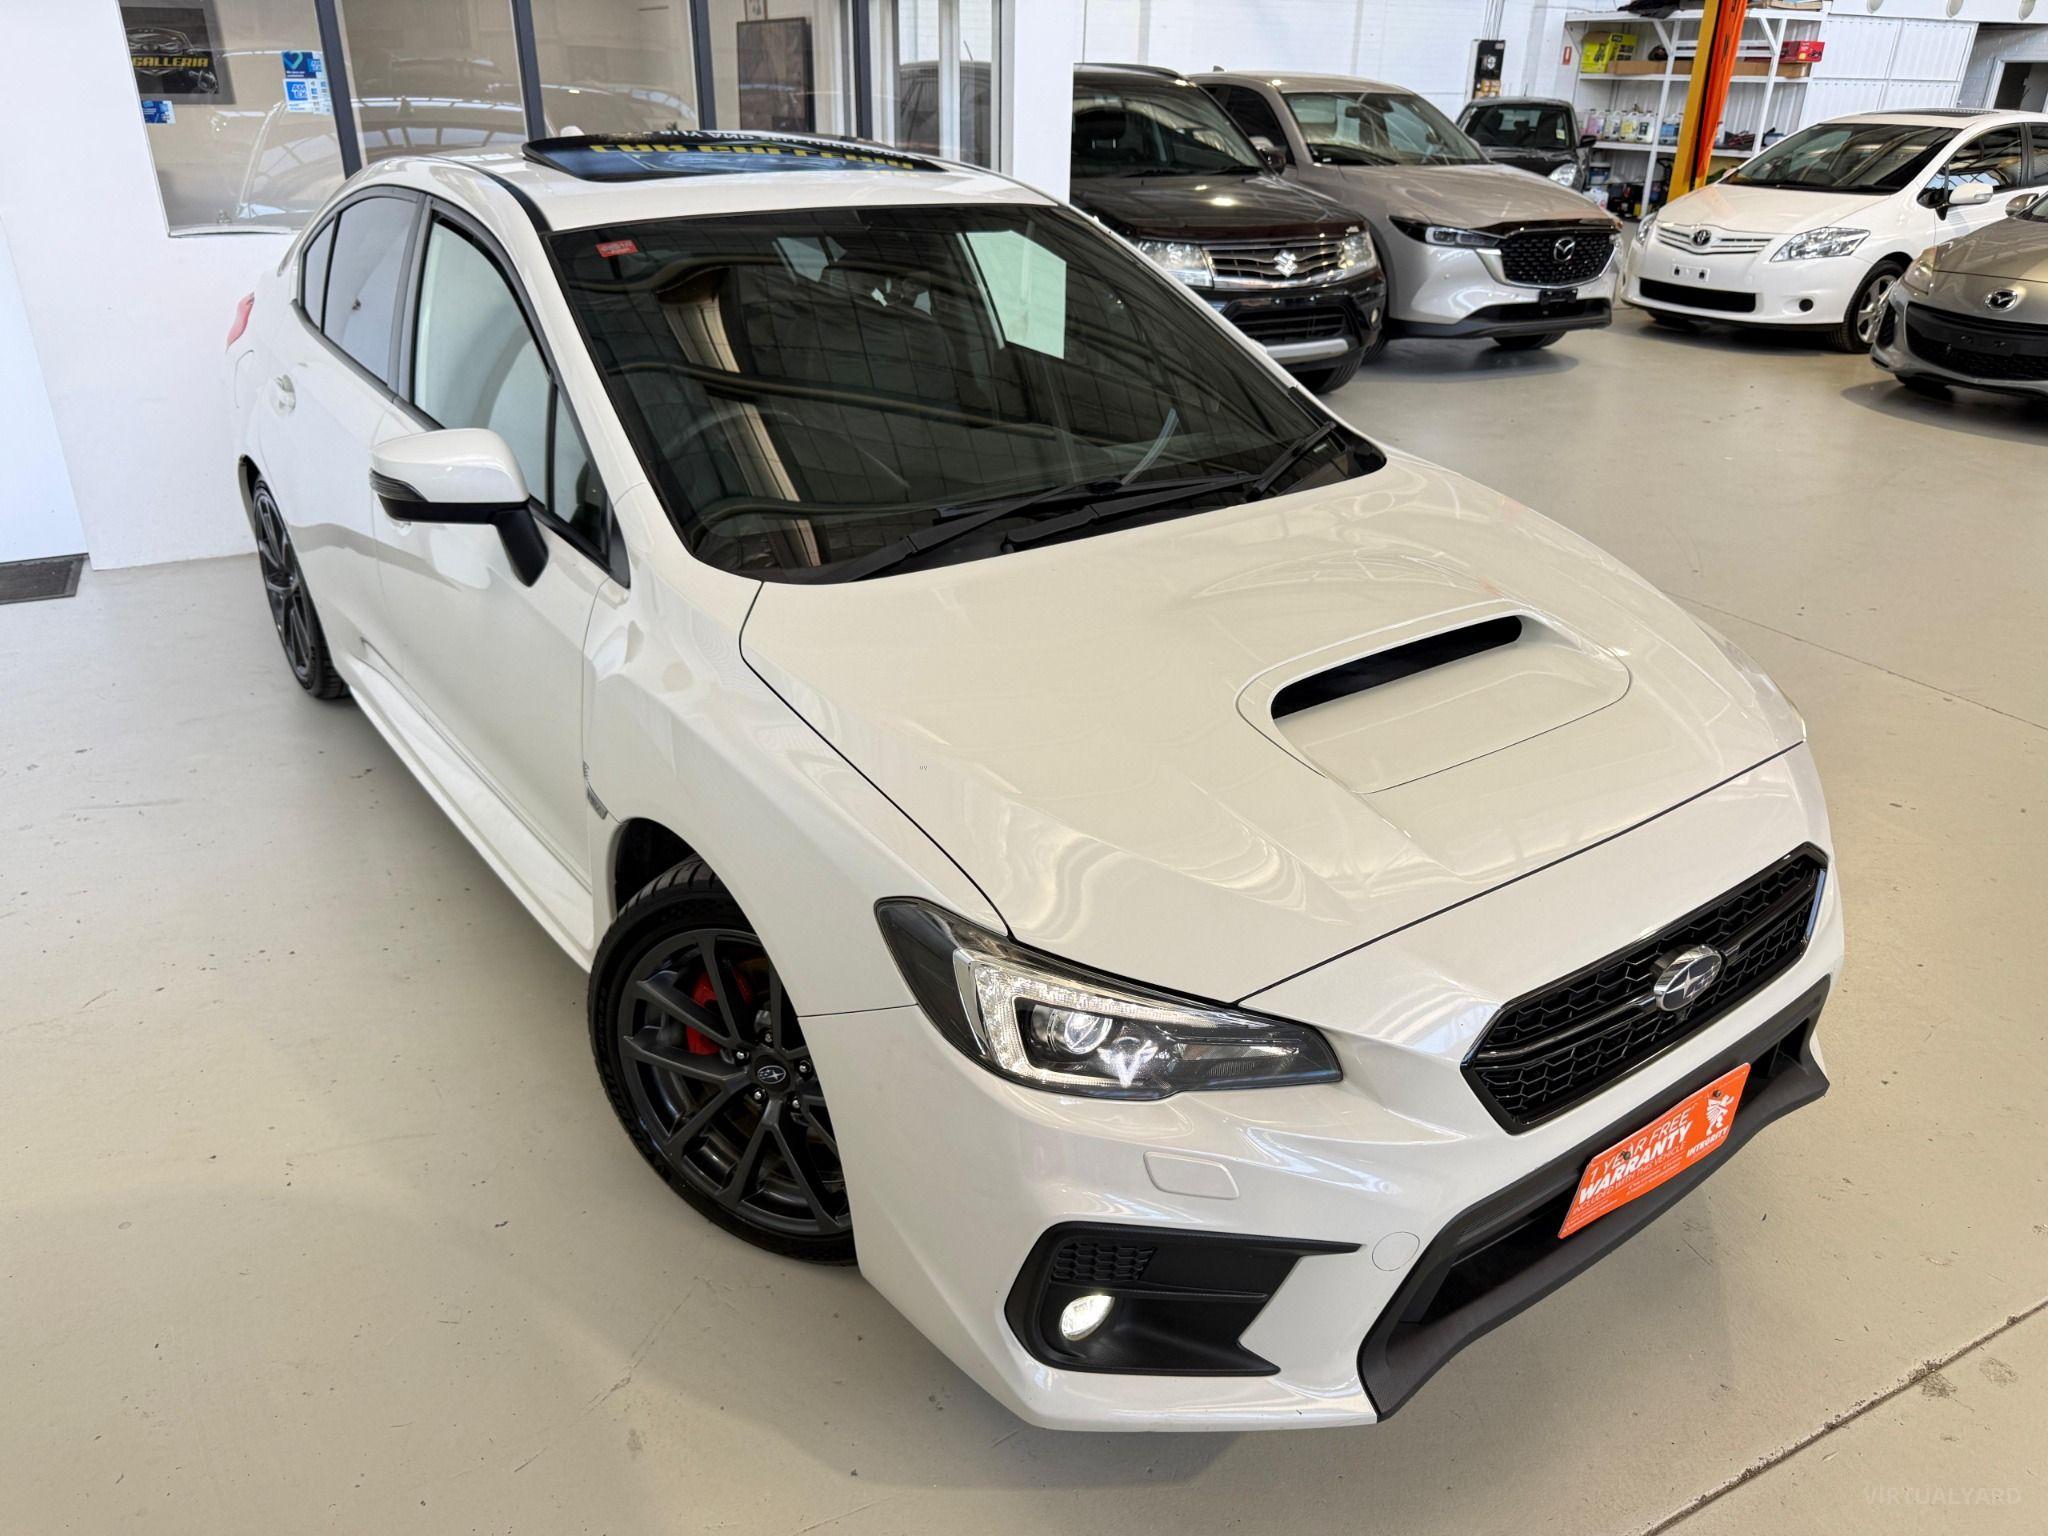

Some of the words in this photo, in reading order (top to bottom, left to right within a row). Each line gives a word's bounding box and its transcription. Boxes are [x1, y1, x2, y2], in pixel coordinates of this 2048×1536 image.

[131, 56, 209, 68] GALLERIA
[1649, 1108, 1692, 1146] FREE
[1579, 1121, 1692, 1204] WARRANTY
